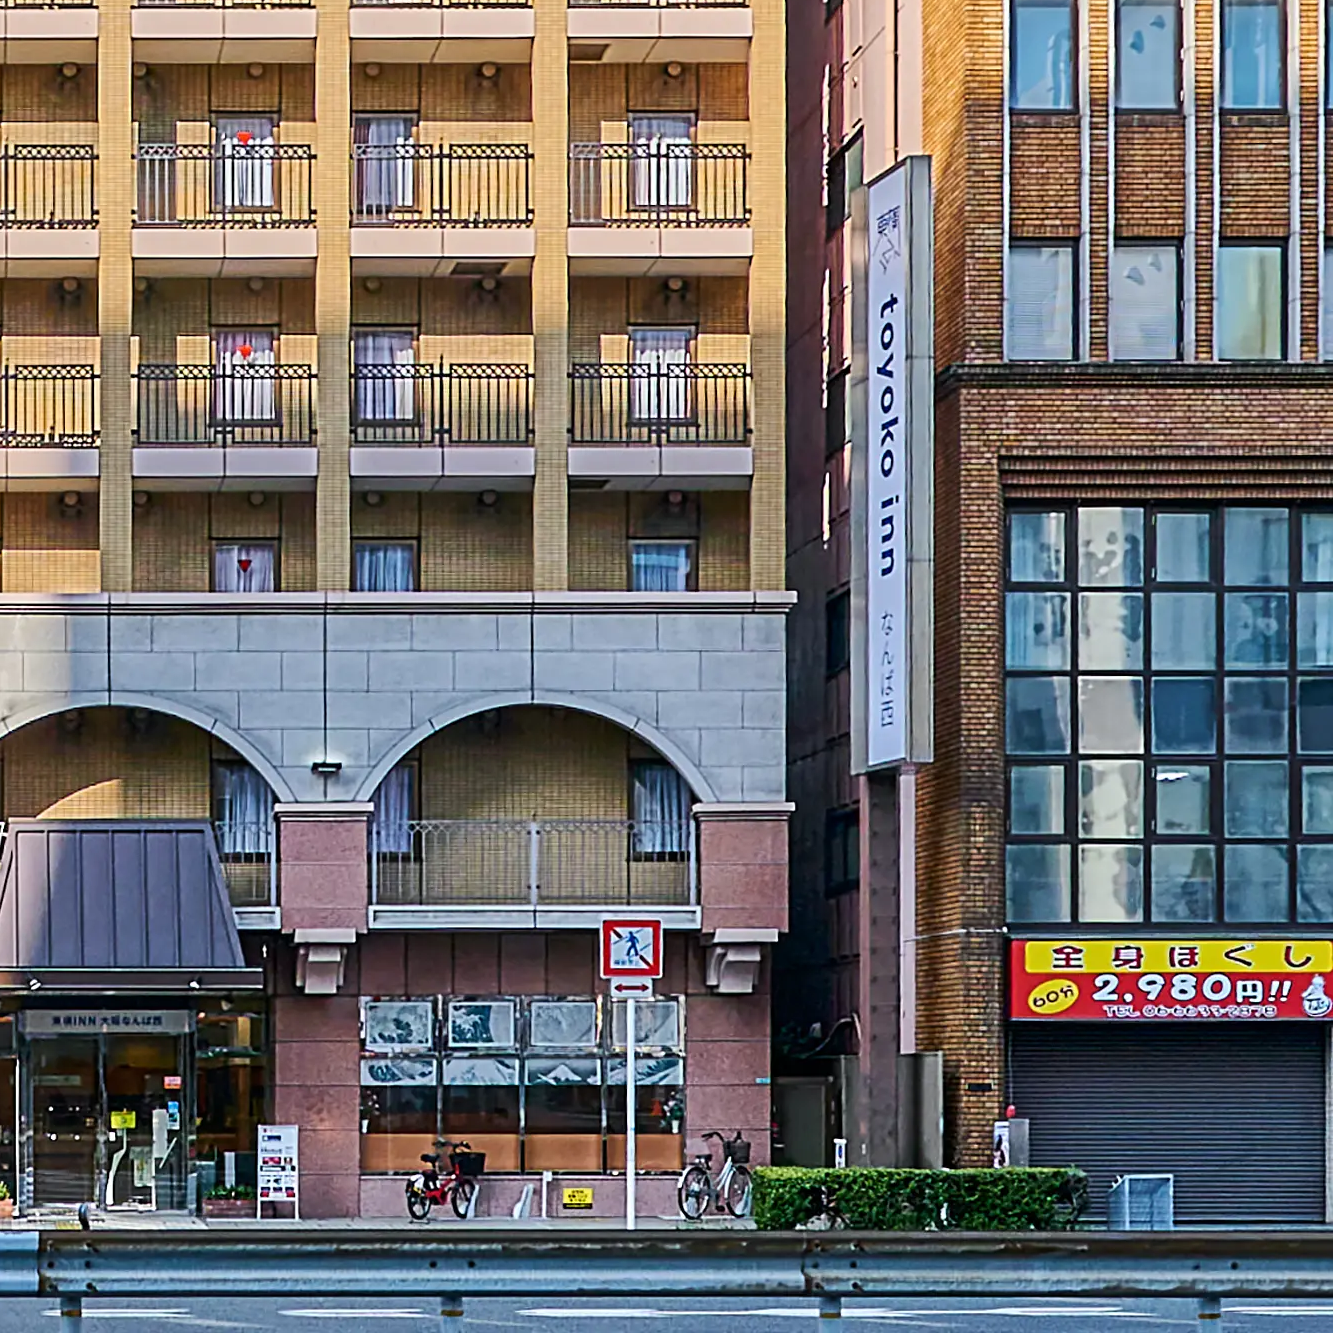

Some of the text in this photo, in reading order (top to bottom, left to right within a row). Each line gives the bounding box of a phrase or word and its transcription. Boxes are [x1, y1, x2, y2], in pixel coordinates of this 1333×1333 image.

[876, 293, 899, 577] toyoko inn
[1051, 945, 1313, 970] 全身ほぐし
[1032, 984, 1076, 1008] 60分
[1102, 1004, 1141, 1018] TEL
